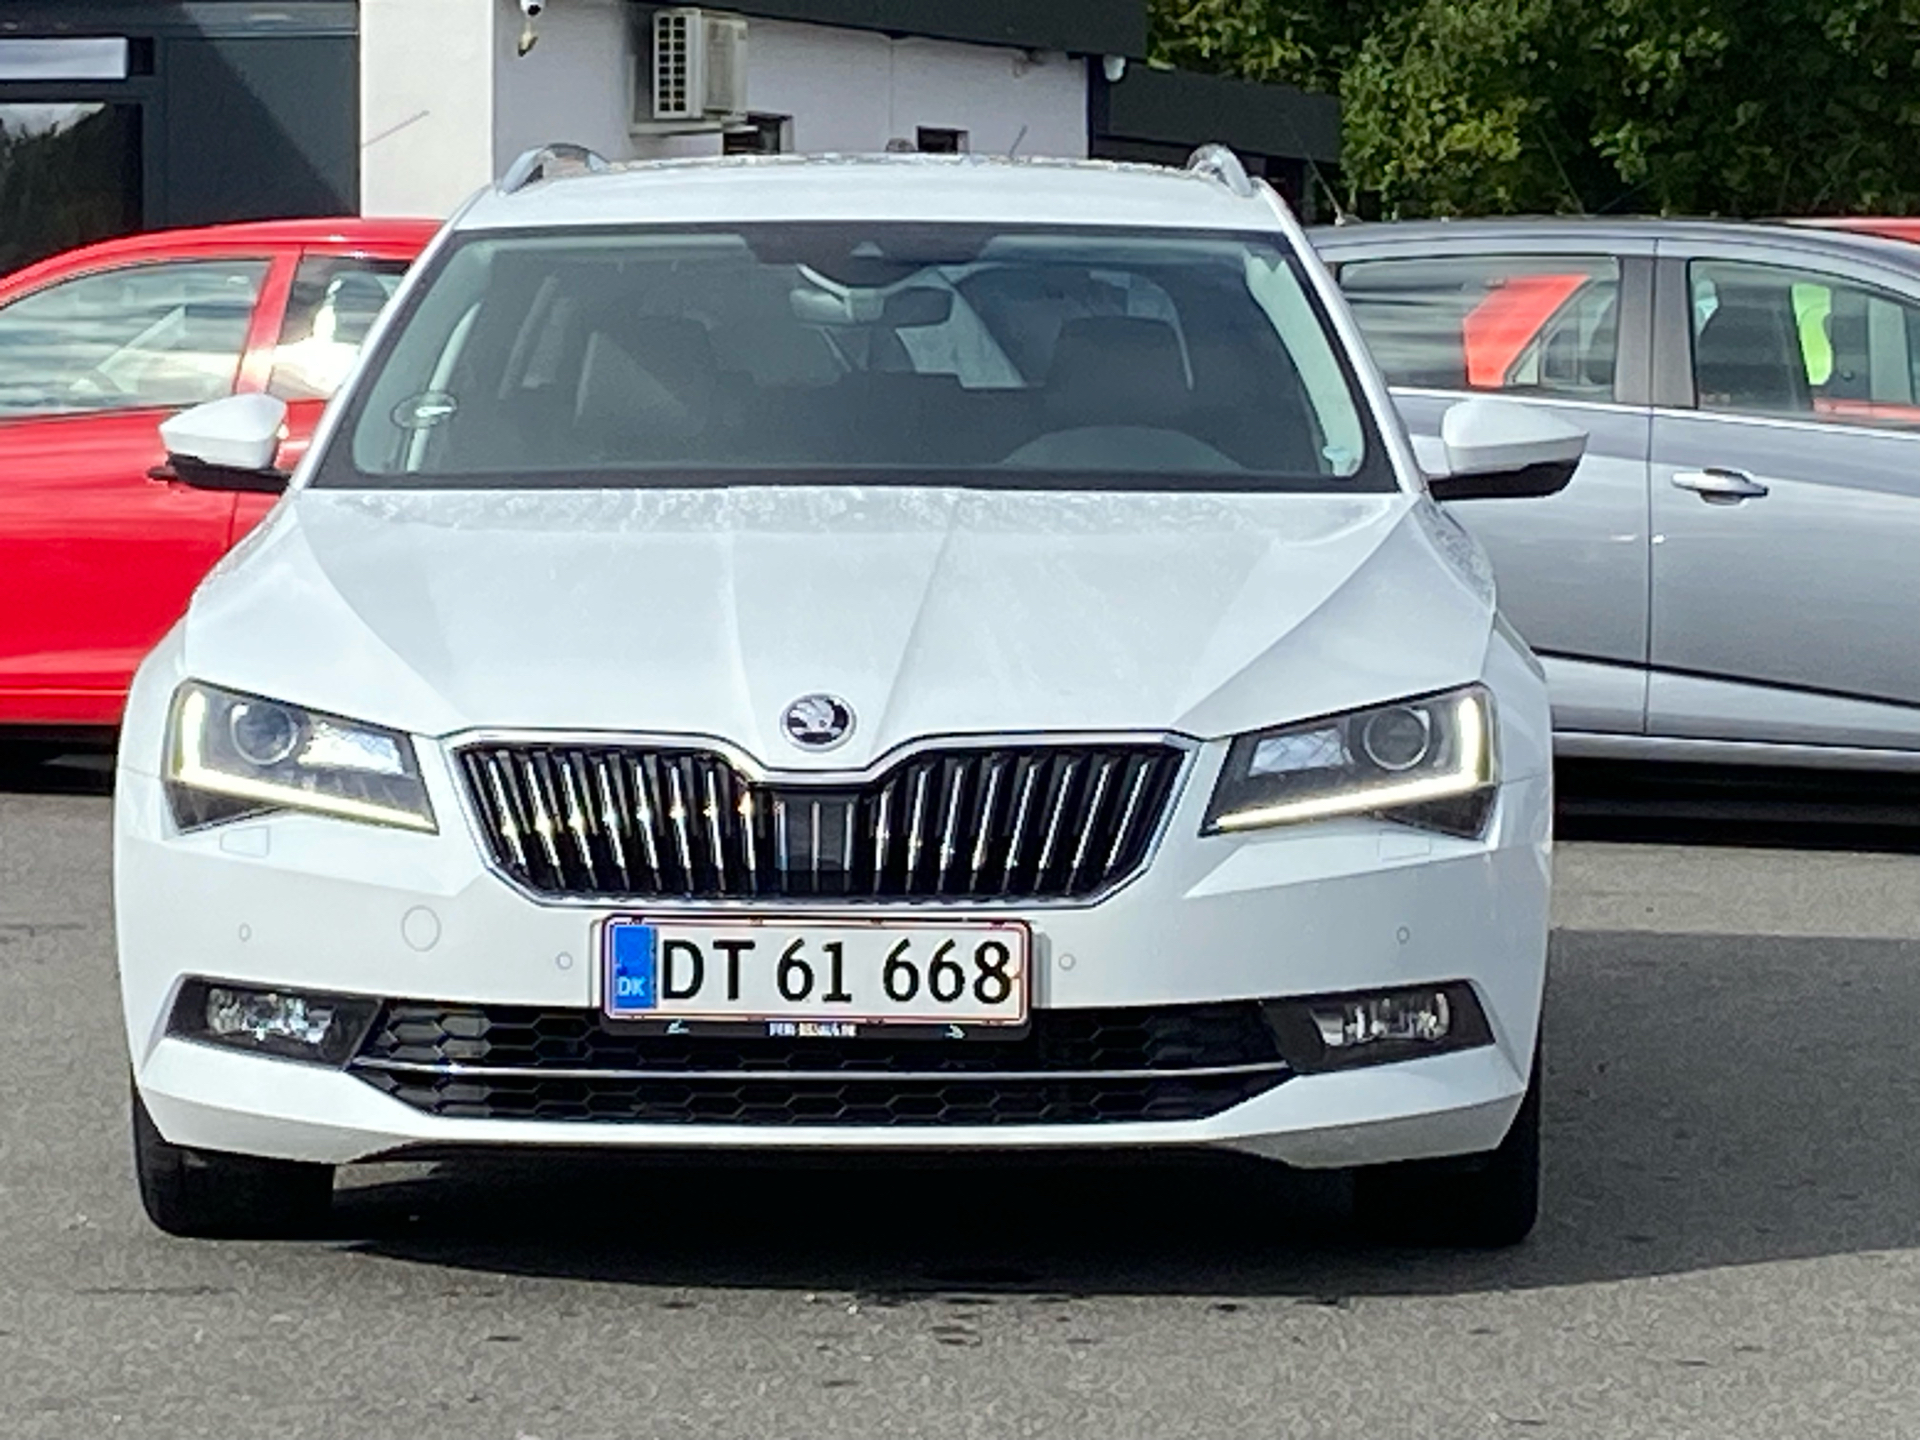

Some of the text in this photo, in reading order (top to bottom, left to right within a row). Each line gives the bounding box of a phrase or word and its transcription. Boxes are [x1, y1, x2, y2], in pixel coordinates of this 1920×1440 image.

[617, 976, 646, 997] DK
[661, 938, 1012, 1005] DT 61 668
